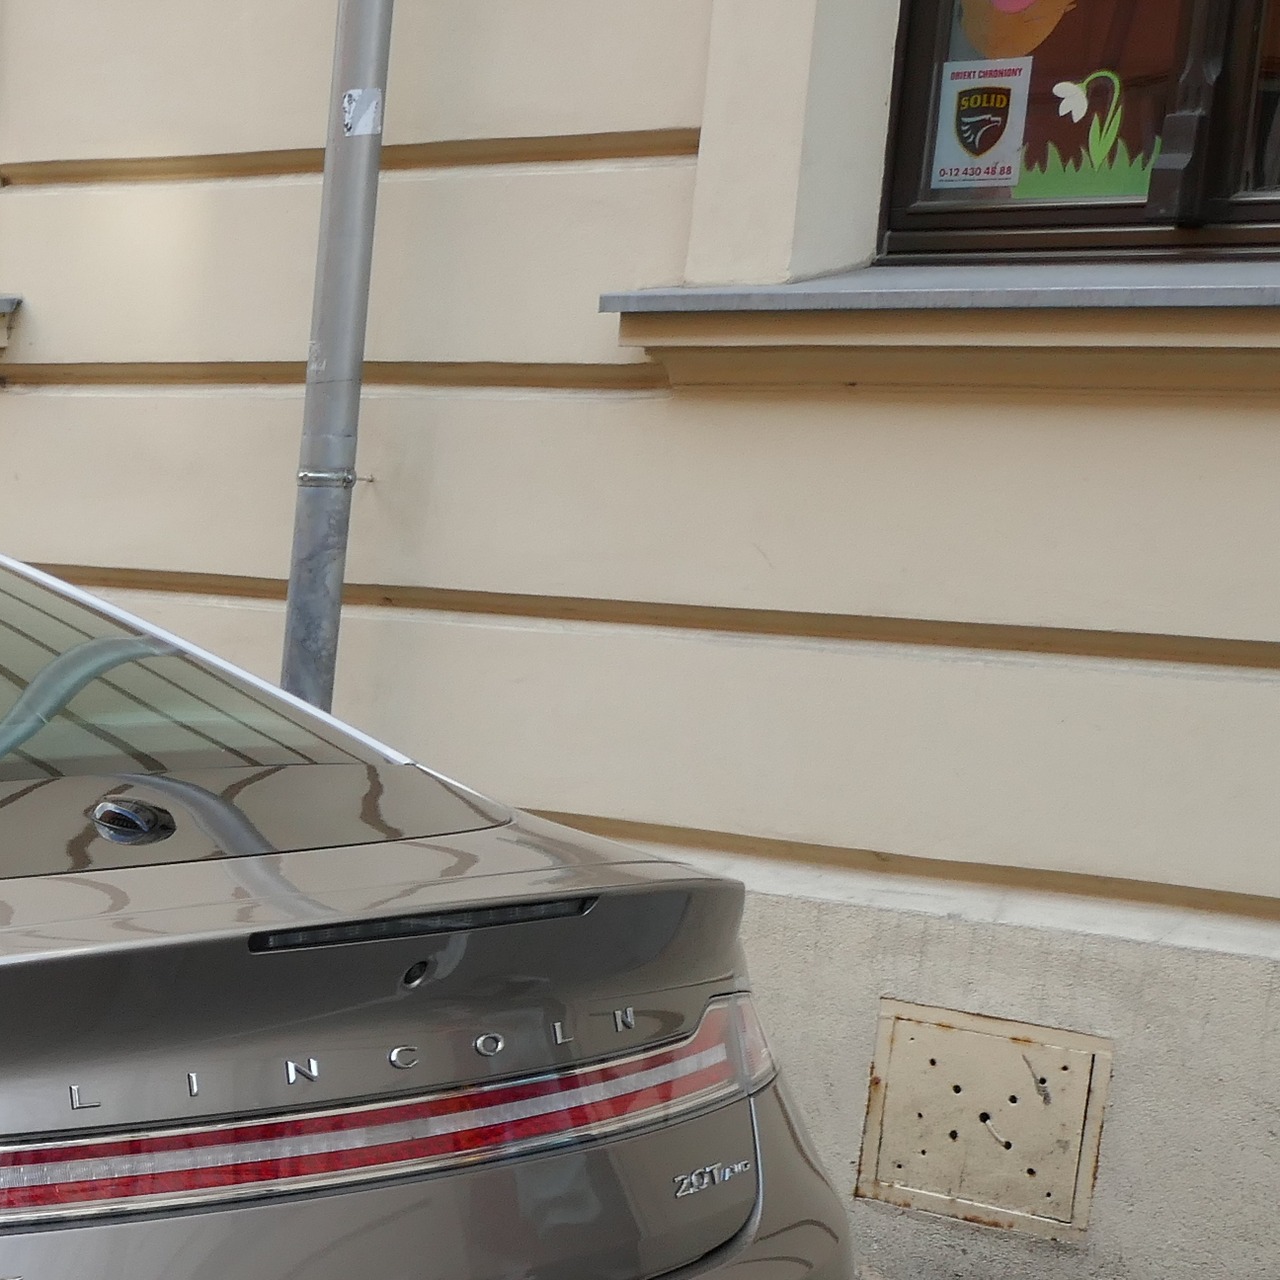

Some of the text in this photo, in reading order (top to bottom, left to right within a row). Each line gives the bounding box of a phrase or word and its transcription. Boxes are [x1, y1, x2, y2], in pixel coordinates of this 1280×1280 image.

[960, 94, 1008, 110] SOLID
[939, 167, 960, 178] 0-12
[962, 166, 982, 177] 430
[999, 165, 1013, 176] 88
[69, 1005, 636, 1110] LINCOLN
